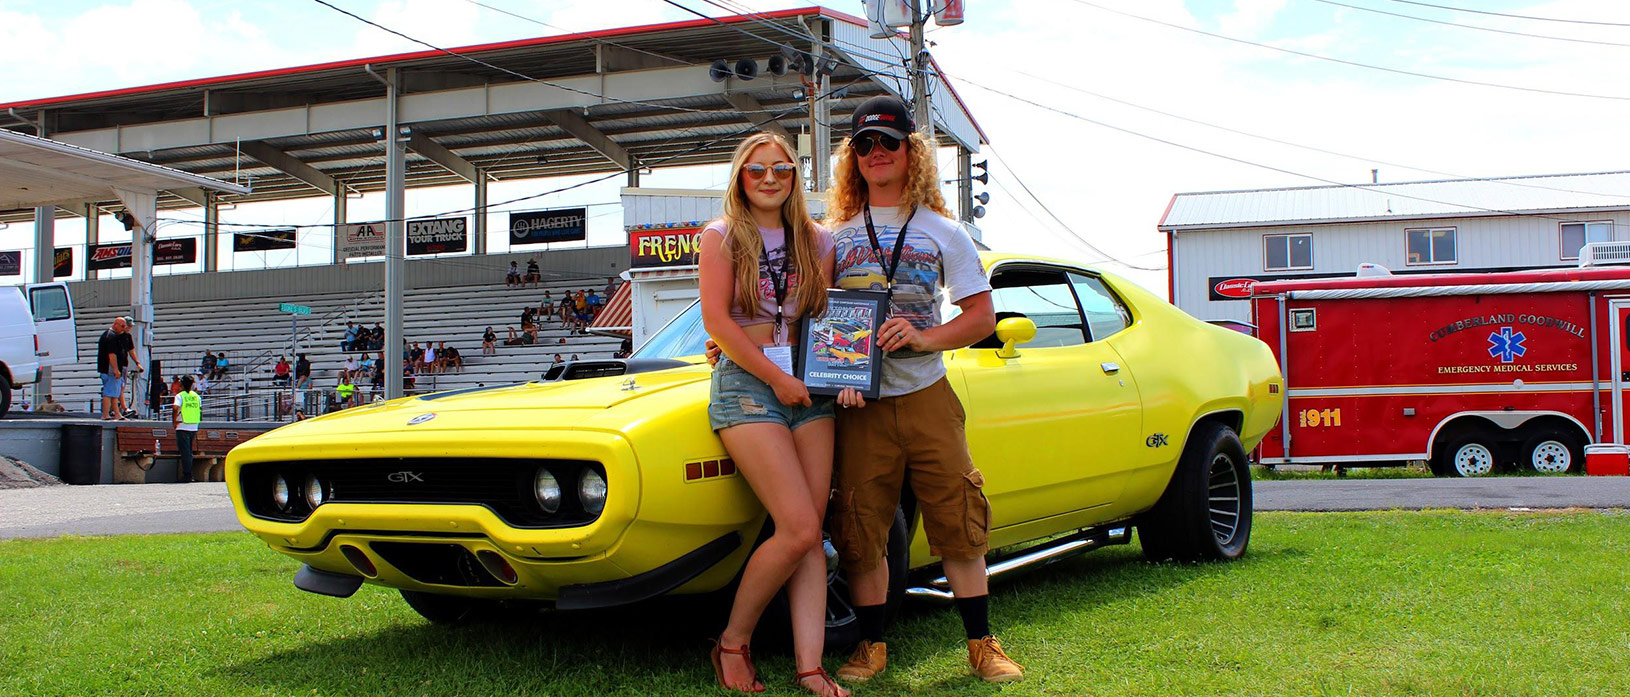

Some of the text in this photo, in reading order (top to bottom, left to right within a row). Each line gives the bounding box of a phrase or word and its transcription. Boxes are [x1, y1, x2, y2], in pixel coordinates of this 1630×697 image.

[409, 219, 464, 235] EXTANG
[531, 216, 583, 230] HAGERTY
[408, 233, 463, 244] YOUR TRUCK
[1429, 314, 1585, 342] CUMBERLAND GOODWILL
[809, 371, 841, 379] CELEBRITY
[1438, 363, 1577, 374] EMERGENCY MEDICAL SERVICES
[1306, 408, 1341, 427] 911
[1146, 433, 1169, 448] GTX
[387, 471, 424, 483] GTX
